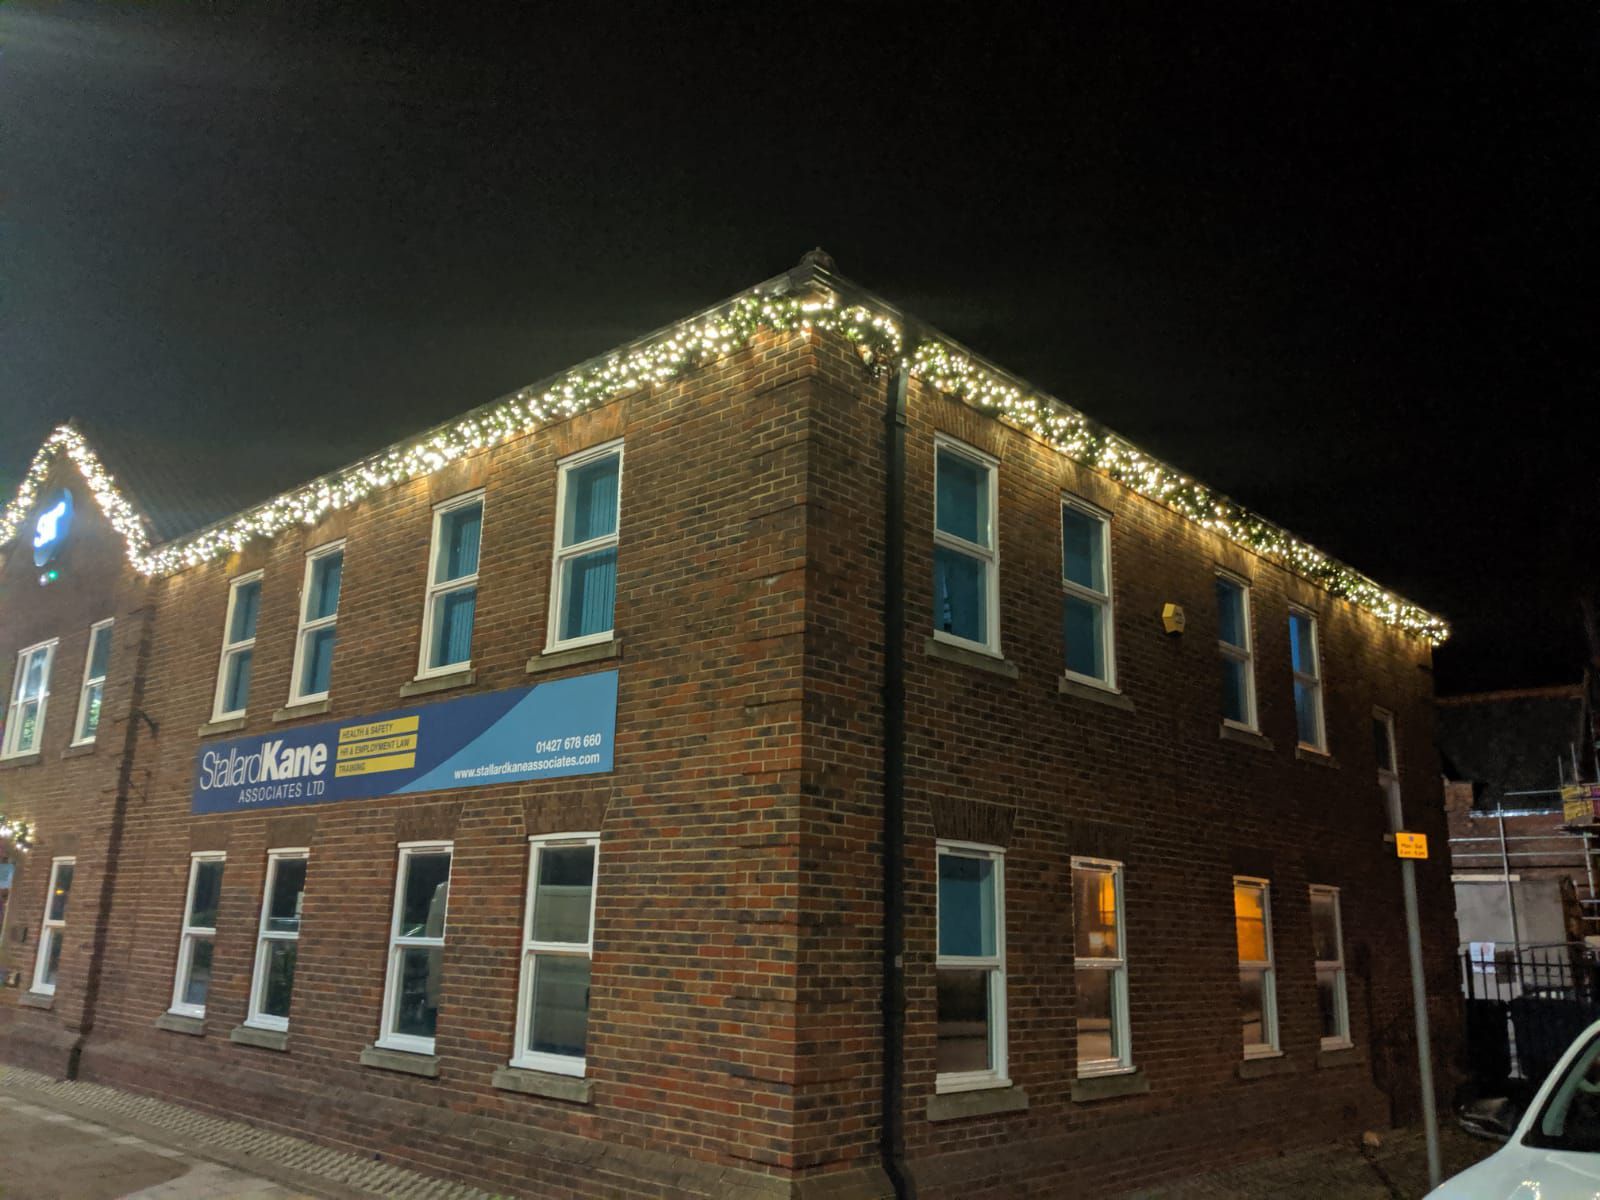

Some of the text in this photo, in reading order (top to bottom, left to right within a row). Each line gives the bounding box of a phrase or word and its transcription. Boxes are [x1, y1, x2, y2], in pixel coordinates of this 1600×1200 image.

[342, 727, 364, 739] HEALTH
[370, 723, 394, 735] SAFETY
[355, 740, 395, 754] EMPLOYMENT
[396, 738, 410, 748] LAW
[536, 733, 601, 753] 01427 678 660
[339, 762, 366, 773] TRAINING
[454, 752, 600, 779] www.stallardkaneassociates.com
[238, 780, 325, 803] ASSOCIATES LTD
